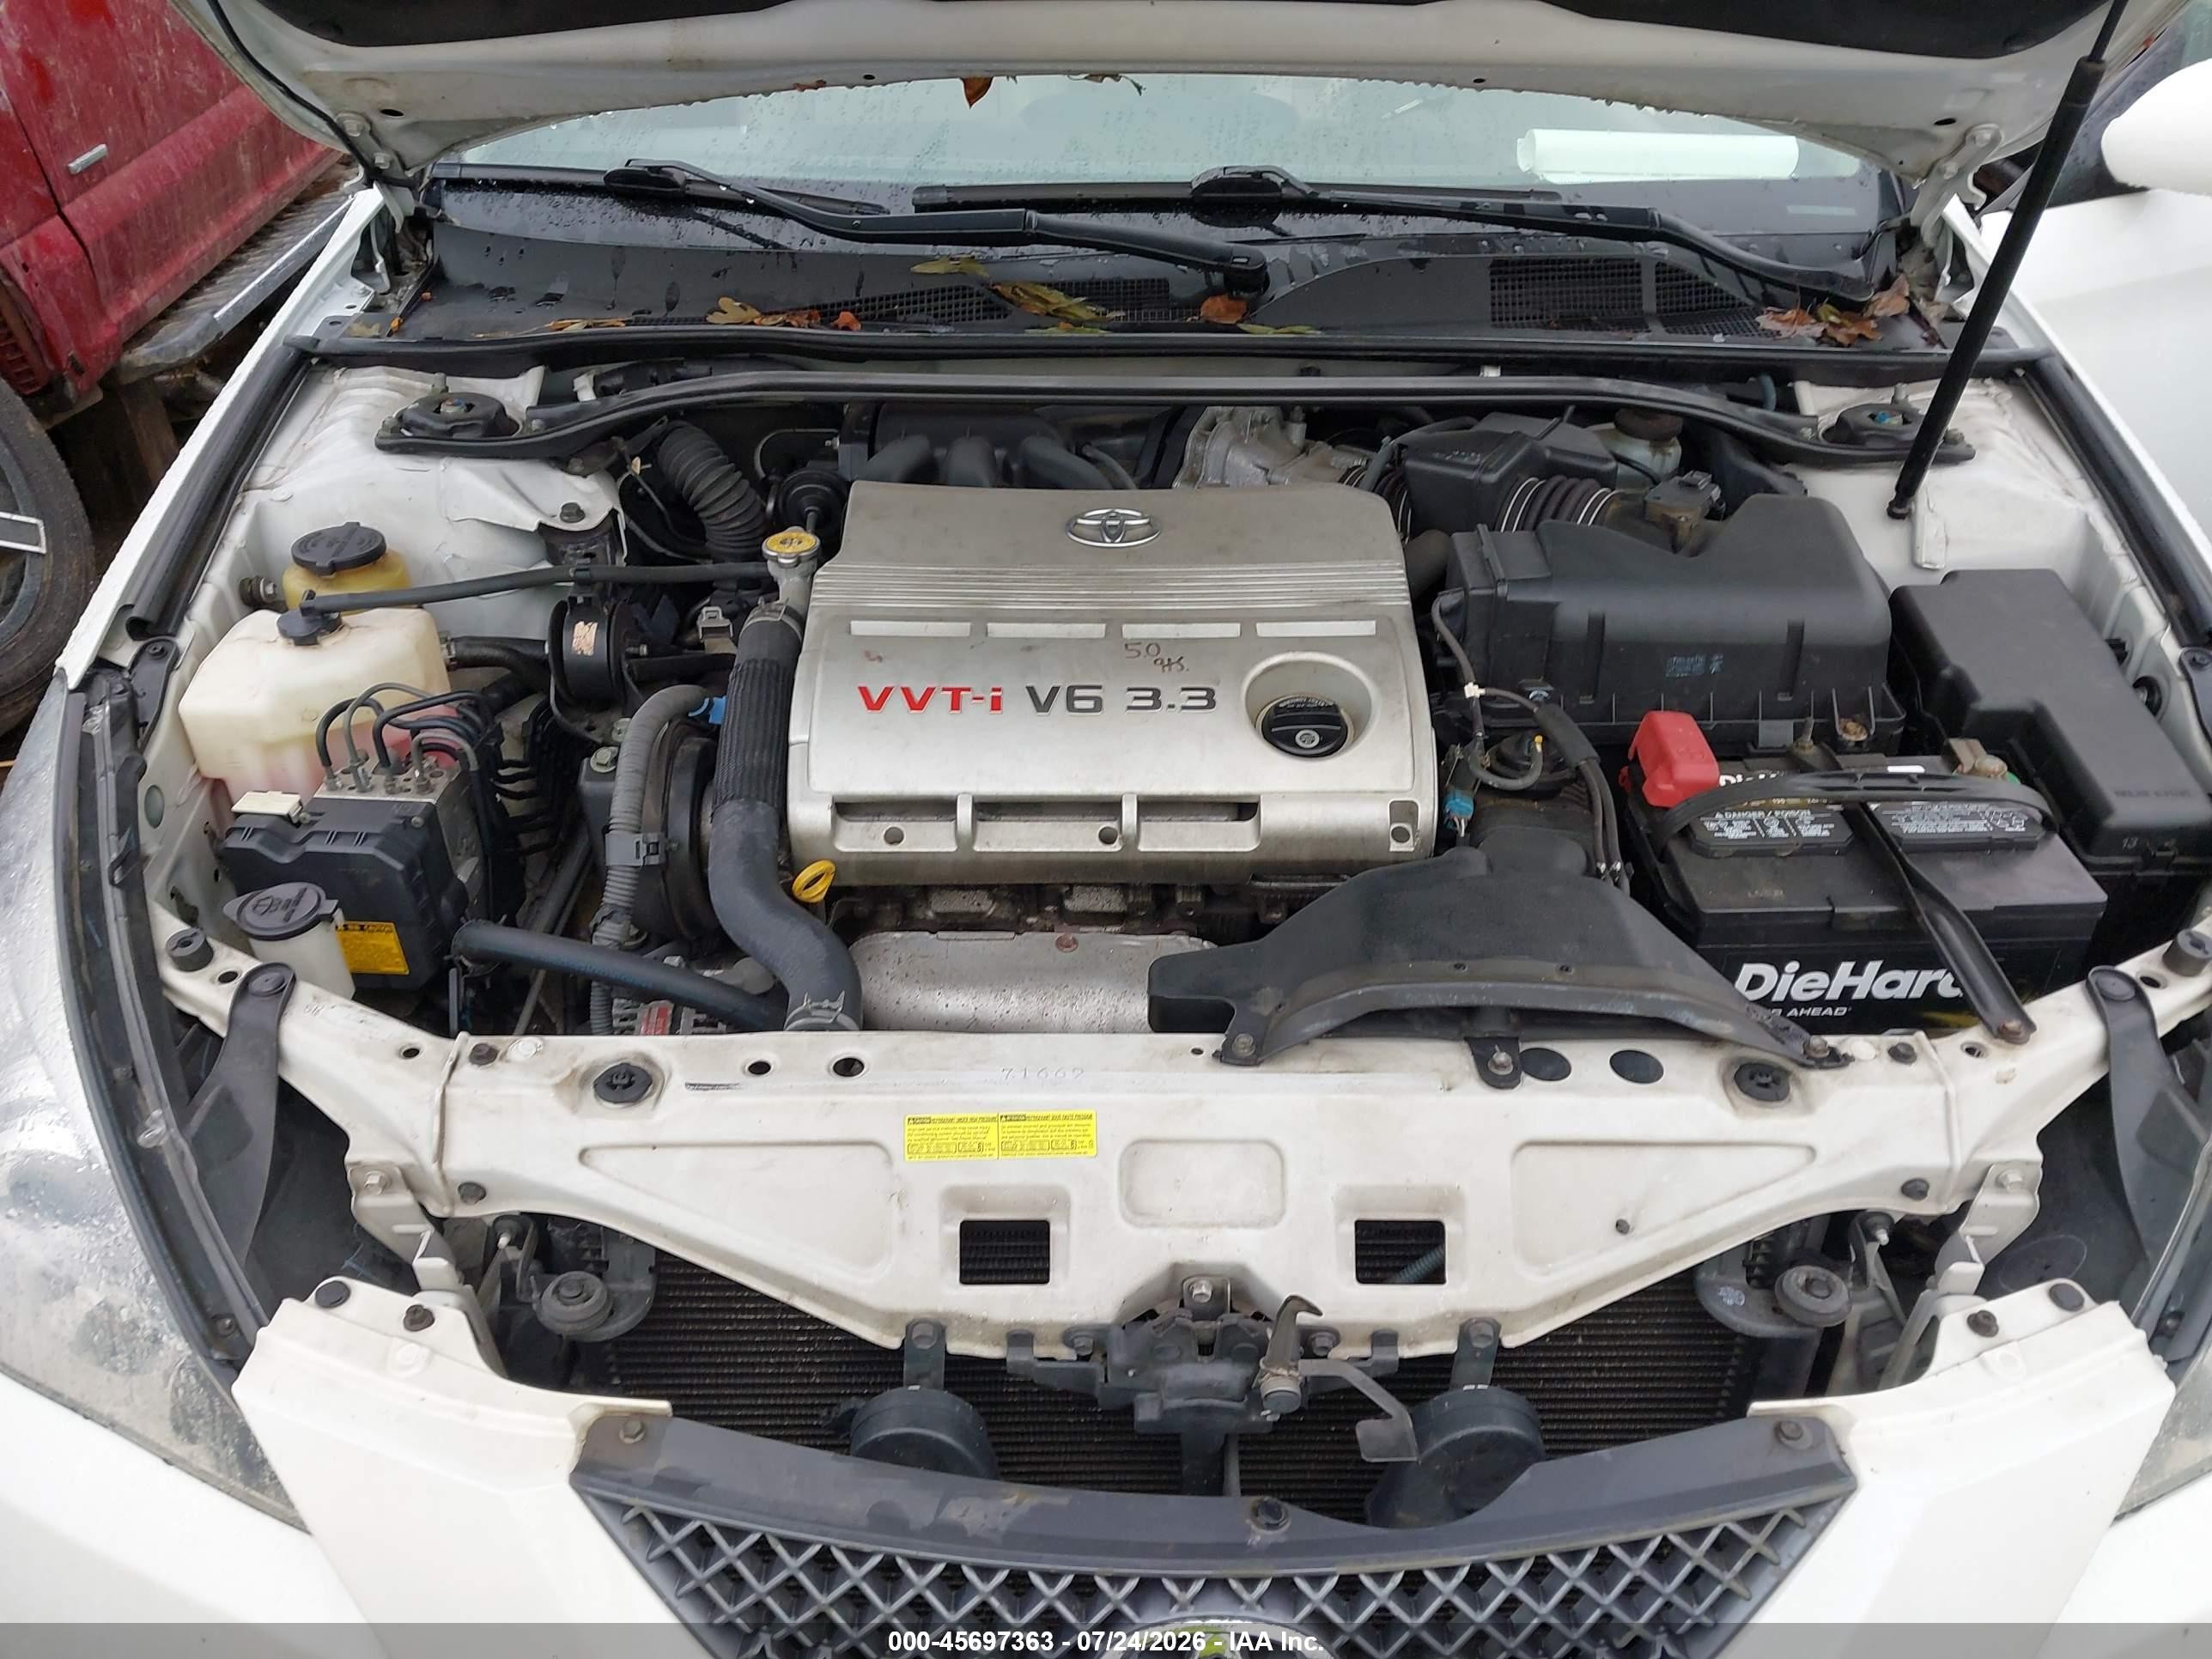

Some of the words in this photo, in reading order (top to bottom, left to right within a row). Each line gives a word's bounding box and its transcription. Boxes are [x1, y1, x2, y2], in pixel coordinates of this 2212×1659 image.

[857, 684, 1004, 714] VVT-i
[1024, 684, 1103, 714] V6
[1125, 685, 1217, 713] 3.3
